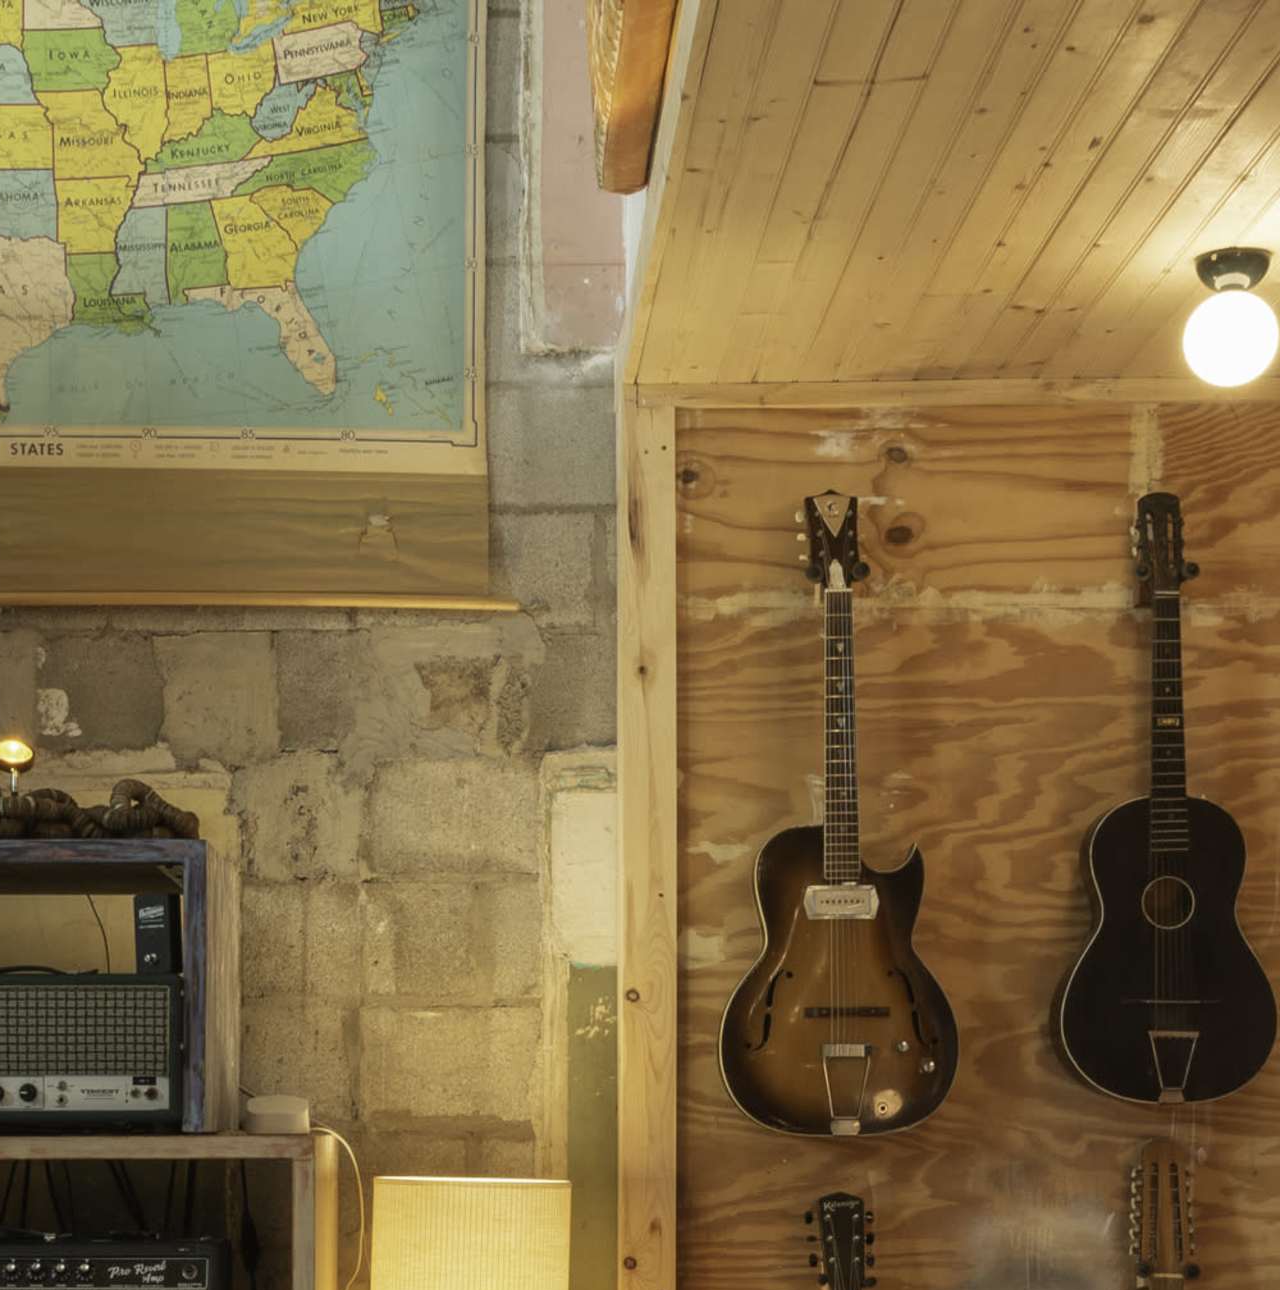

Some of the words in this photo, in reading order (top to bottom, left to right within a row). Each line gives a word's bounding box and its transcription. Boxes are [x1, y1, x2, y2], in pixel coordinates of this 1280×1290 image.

[302, 10, 328, 25] NEW
[331, 5, 361, 19] YORK
[48, 50, 91, 61] IOWA
[283, 38, 352, 60] PENNSYLVANIA
[224, 72, 262, 85] OHIO
[113, 86, 159, 99] ILLINOIS
[166, 88, 209, 100] INDIANA
[295, 120, 342, 137] VIRGINIA
[59, 135, 114, 147] MISSOURI
[171, 144, 231, 160] KENTUCKY
[266, 171, 295, 184] NORTH
[300, 163, 344, 177] CAROLINA
[153, 178, 220, 194] TENNESSEE
[64, 196, 121, 208] ARKANSAS
[278, 208, 320, 220] CAROLINA
[224, 221, 270, 235] GEORGIA
[170, 239, 220, 253] ALABAMA
[83, 296, 137, 308] LOUISIANA
[240, 429, 255, 440] 85
[340, 430, 356, 441] 80
[10, 442, 65, 456] STATES
[108, 1265, 131, 1279] Pro
[142, 1273, 165, 1283] Amp
